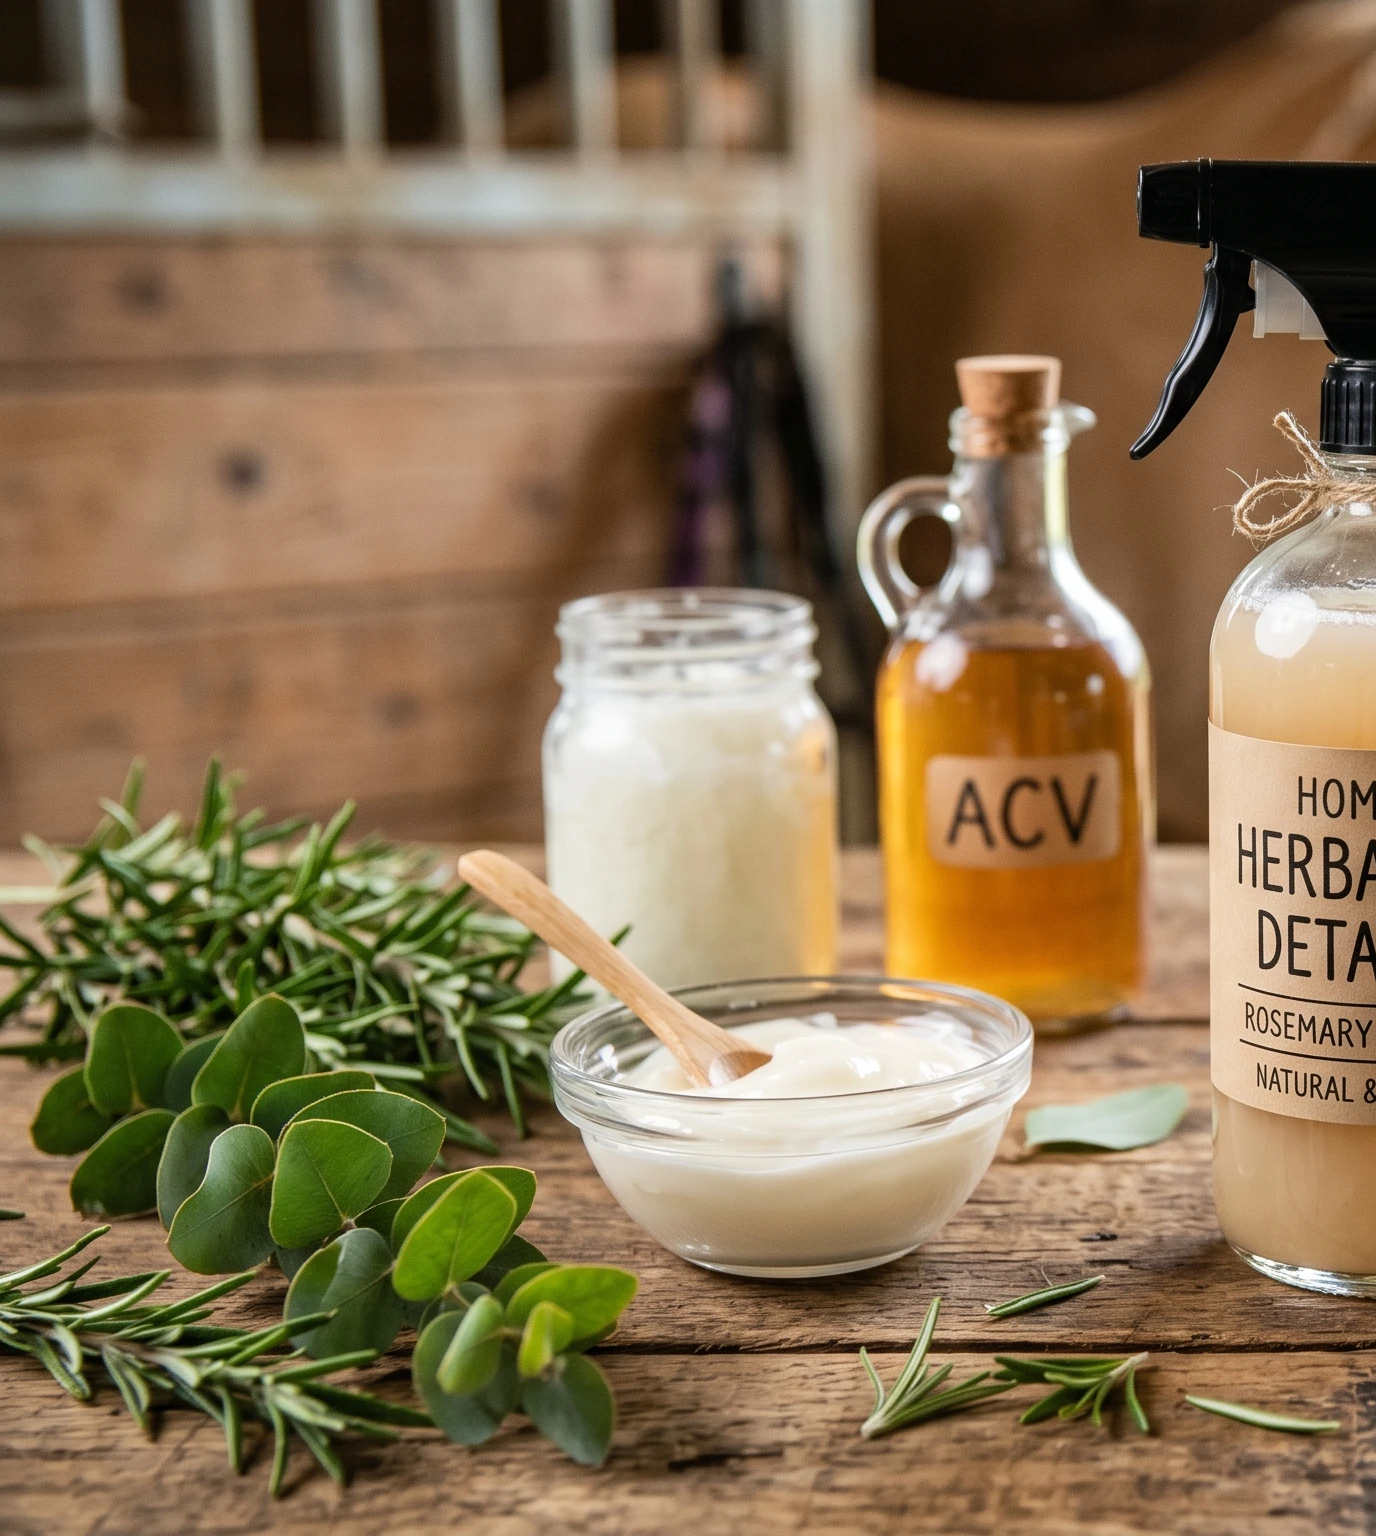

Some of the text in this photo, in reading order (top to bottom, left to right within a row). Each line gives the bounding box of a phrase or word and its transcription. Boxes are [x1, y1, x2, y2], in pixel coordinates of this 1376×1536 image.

[945, 773, 1098, 851] ACV
[1245, 1001, 1374, 1049] ROSEMARY
[1256, 1062, 1355, 1103] NATURAL
